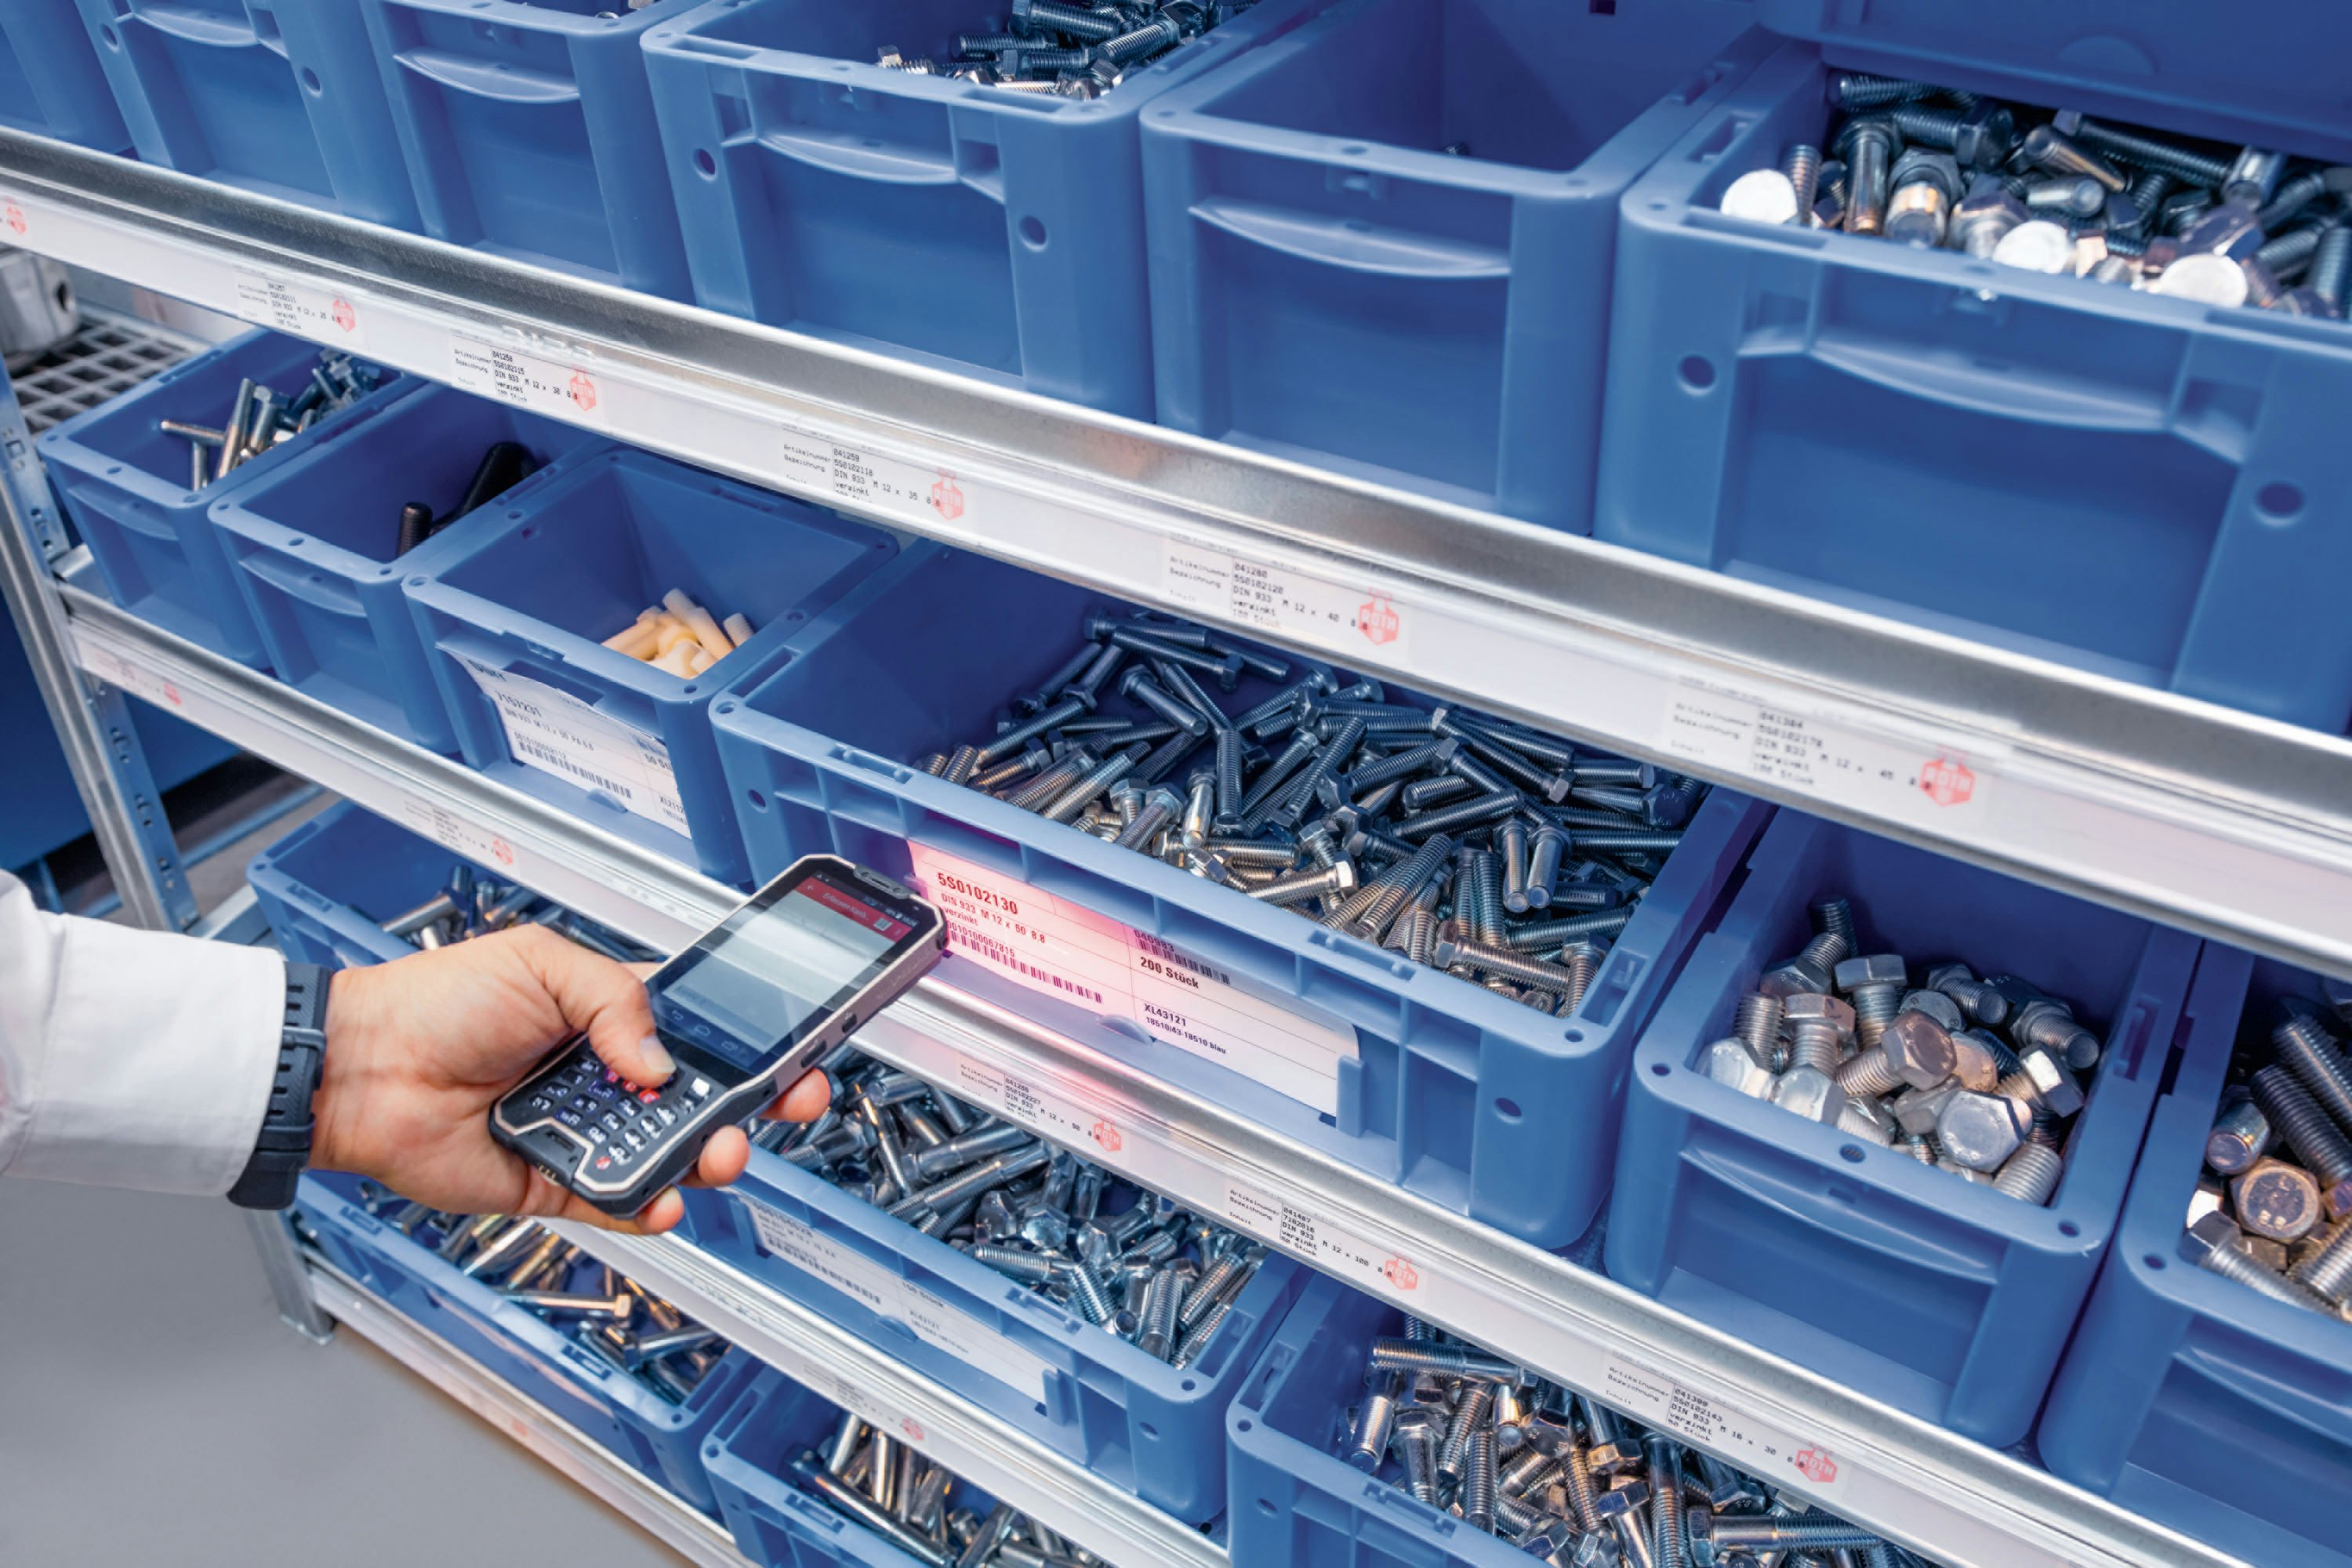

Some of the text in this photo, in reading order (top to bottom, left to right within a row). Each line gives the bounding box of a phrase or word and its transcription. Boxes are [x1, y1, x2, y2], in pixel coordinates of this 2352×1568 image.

[495, 370, 506, 379] DIN
[508, 373, 519, 383] 933
[496, 381, 524, 393] verzinkt
[784, 444, 832, 463] Artikelnummer
[784, 455, 826, 473] Bezeichnung
[834, 470, 848, 481] DIN
[852, 474, 865, 485] 933
[882, 484, 891, 492] 12
[909, 491, 917, 499] 35
[835, 482, 869, 495] verzinkt
[1233, 586, 1250, 597] DIN
[1295, 602, 1305, 612] 12
[1233, 600, 1276, 617] verzinkt
[938, 873, 1018, 914] 5S0102130
[941, 893, 956, 906] DIN
[959, 900, 976, 913] 933
[982, 910, 989, 920] M
[993, 914, 1002, 925] 12
[1015, 924, 1026, 935] 60
[1031, 931, 1045, 943] 8.8
[944, 906, 978, 927] verzinkt
[1141, 956, 1200, 989] 200 Stück
[1144, 1003, 1186, 1026] XL43121
[1210, 1042, 1226, 1054] blau
[960, 1064, 1004, 1087] Artikelnummer
[961, 1072, 997, 1092] Bezeichnung
[1006, 1092, 1018, 1102] DIN
[1022, 1099, 1033, 1109] 933
[1007, 1101, 1037, 1118] verzinkt
[1230, 1189, 1279, 1216] Artikelnummer
[1230, 1196, 1272, 1221] Bezeichnung
[1283, 1207, 1312, 1223] 041487
[1283, 1215, 1315, 1233] 7182016
[1282, 1231, 1318, 1250] verzinkt
[1282, 1221, 1296, 1233] DIN
[1301, 1229, 1314, 1240] 933
[1332, 1245, 1341, 1254] 12
[1355, 1256, 1369, 1266] 100
[1608, 1374, 1659, 1403] Bezeichnung
[1609, 1367, 1669, 1397] Artikelnummer
[1673, 1396, 1723, 1422] 5S0102143
[1669, 1413, 1712, 1435] verzinkt
[1671, 1403, 1688, 1415] DIN
[1693, 1413, 1710, 1426] 933
[1732, 1431, 1743, 1440] 16
[1765, 1446, 1776, 1455] 30
[1798, 1452, 1835, 1478] ROTH
